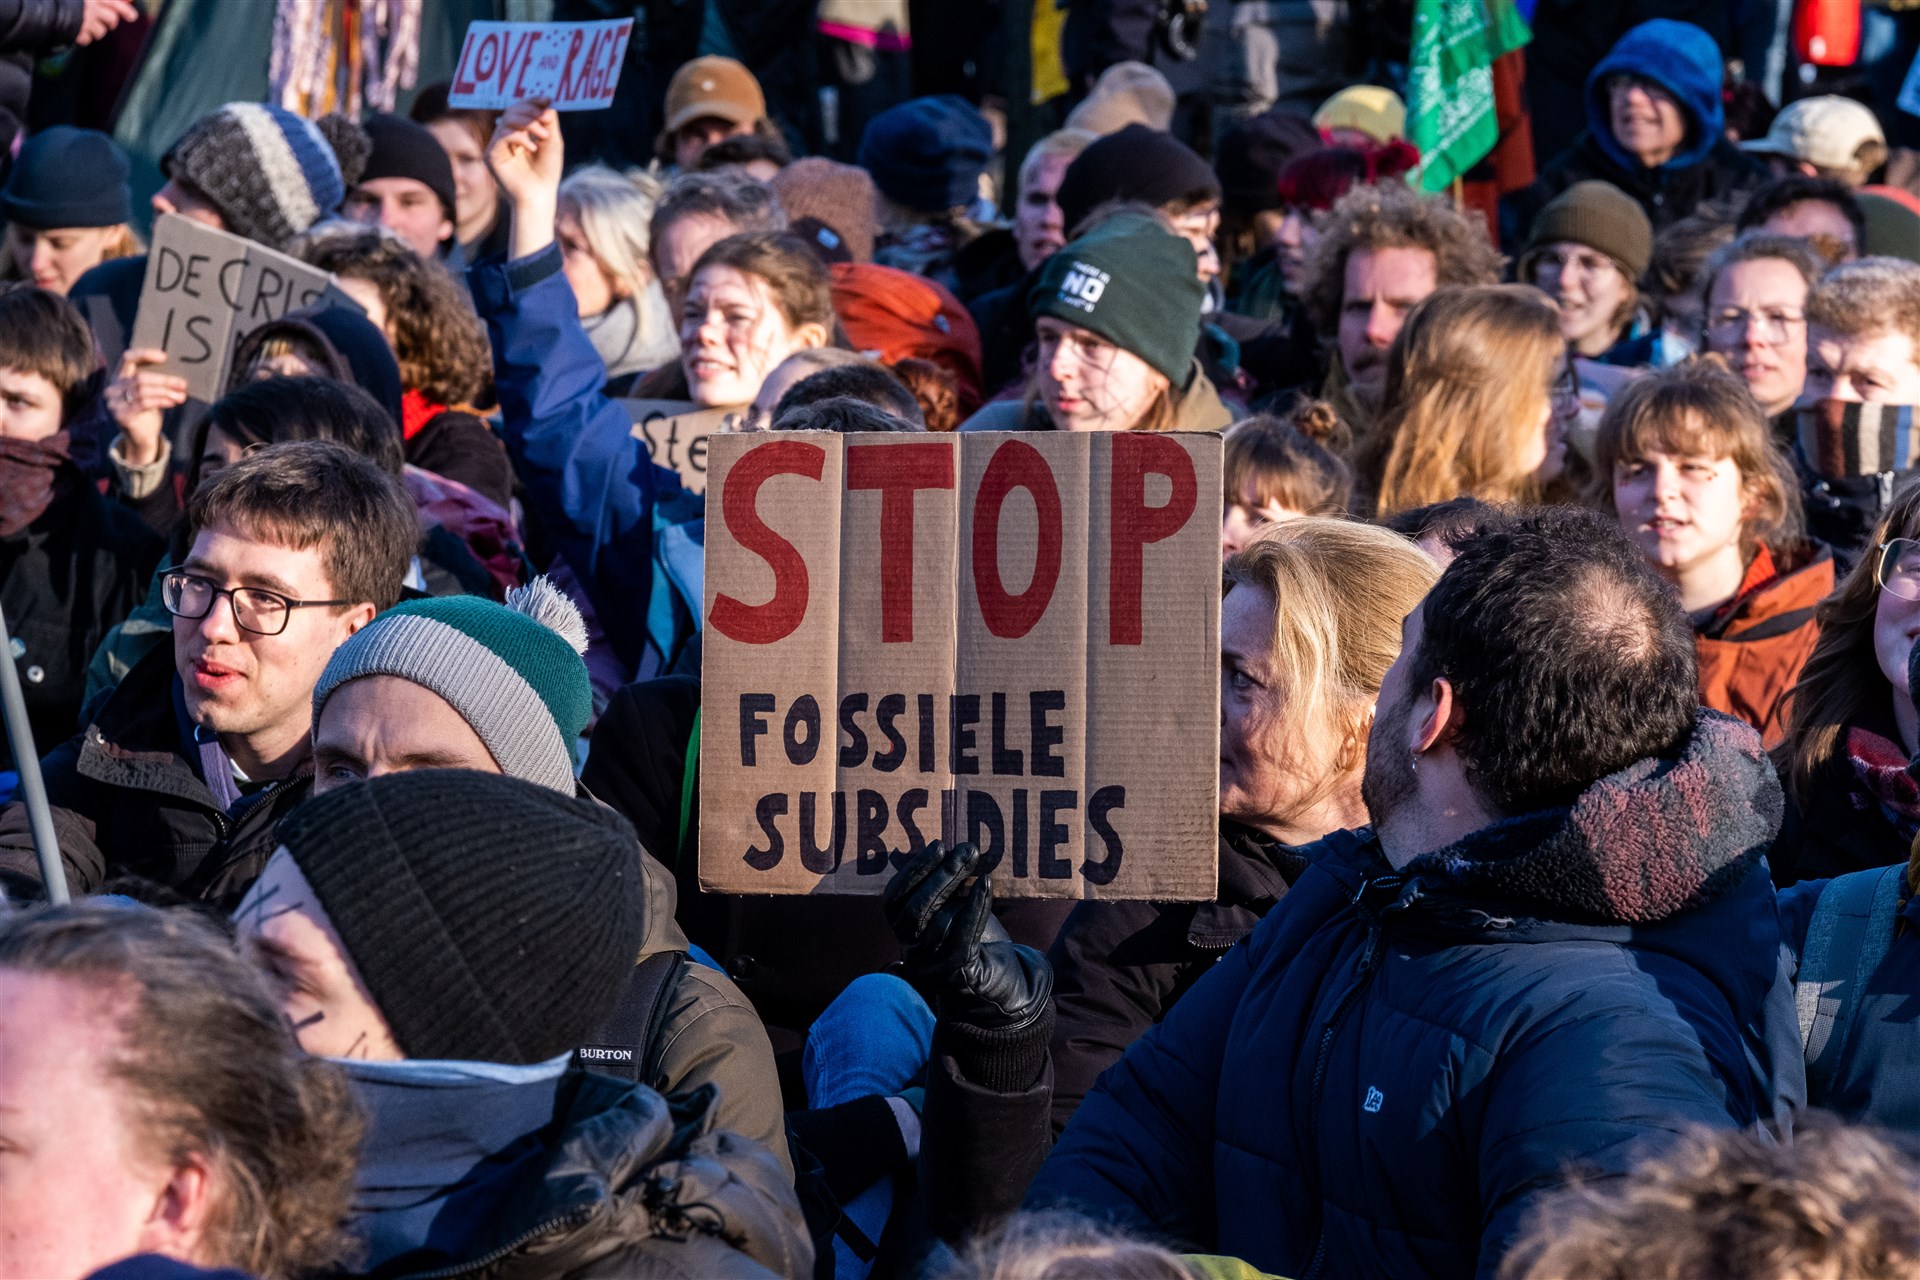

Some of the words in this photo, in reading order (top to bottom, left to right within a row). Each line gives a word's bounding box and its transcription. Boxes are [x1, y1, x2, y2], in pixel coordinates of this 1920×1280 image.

[454, 31, 542, 98] LOVE
[539, 55, 561, 70] AND
[556, 26, 630, 101] RAGE
[155, 246, 211, 299] DE
[1061, 270, 1106, 303] NO
[161, 307, 212, 363] IS
[708, 432, 1198, 646] STOP
[739, 690, 1066, 777] FOSSIELE
[743, 785, 1126, 885] SUBSIDIES
[580, 1048, 632, 1060] BURTON
[1363, 1085, 1384, 1113] Lee
